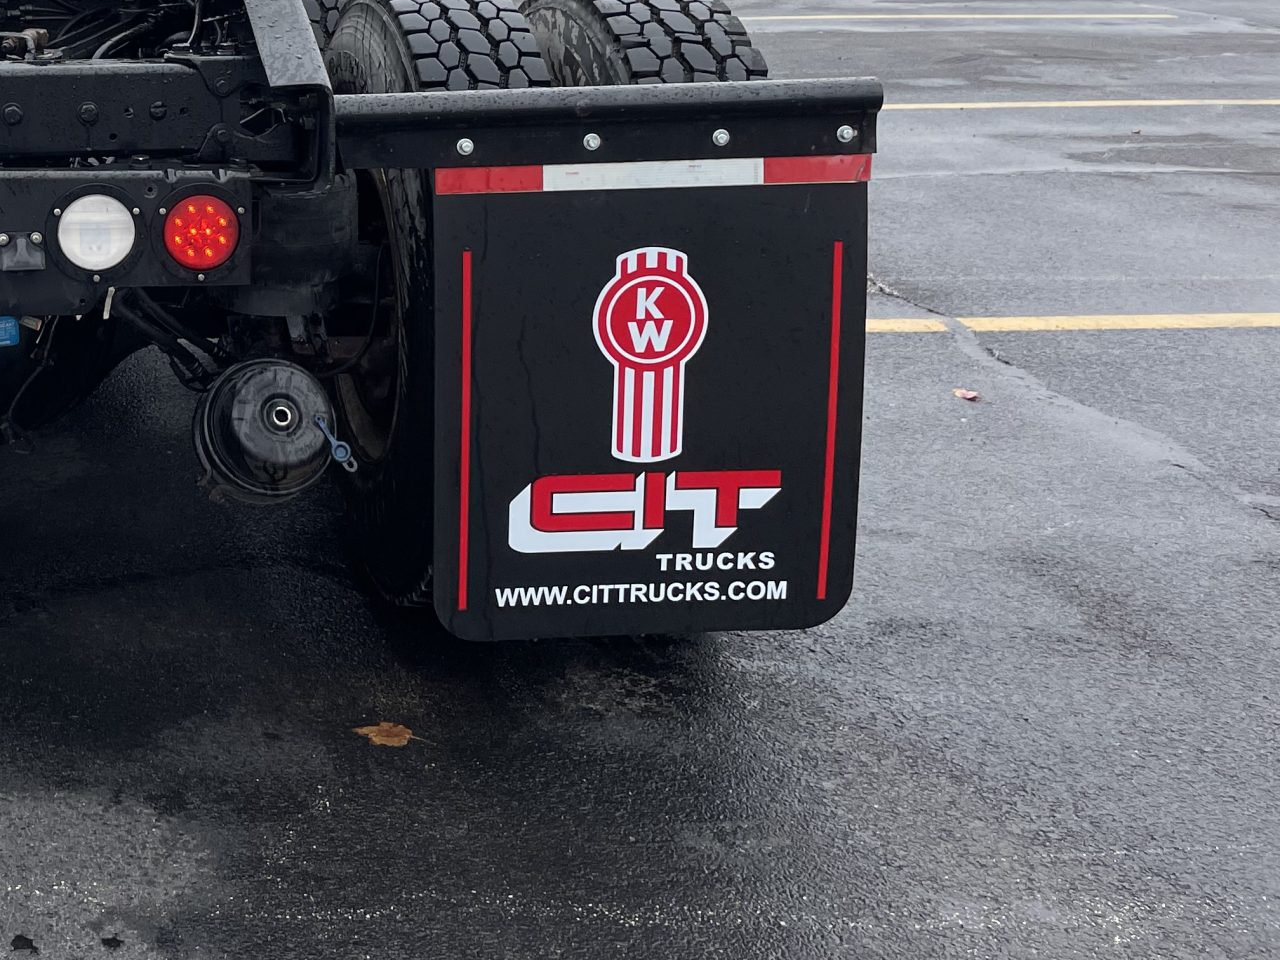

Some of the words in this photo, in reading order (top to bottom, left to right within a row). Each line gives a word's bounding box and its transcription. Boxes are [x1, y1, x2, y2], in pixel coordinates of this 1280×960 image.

[508, 470, 782, 554] CIT
[655, 551, 775, 571] TRUCKS
[495, 580, 788, 608] WWW.CITTRUCKS.COM
